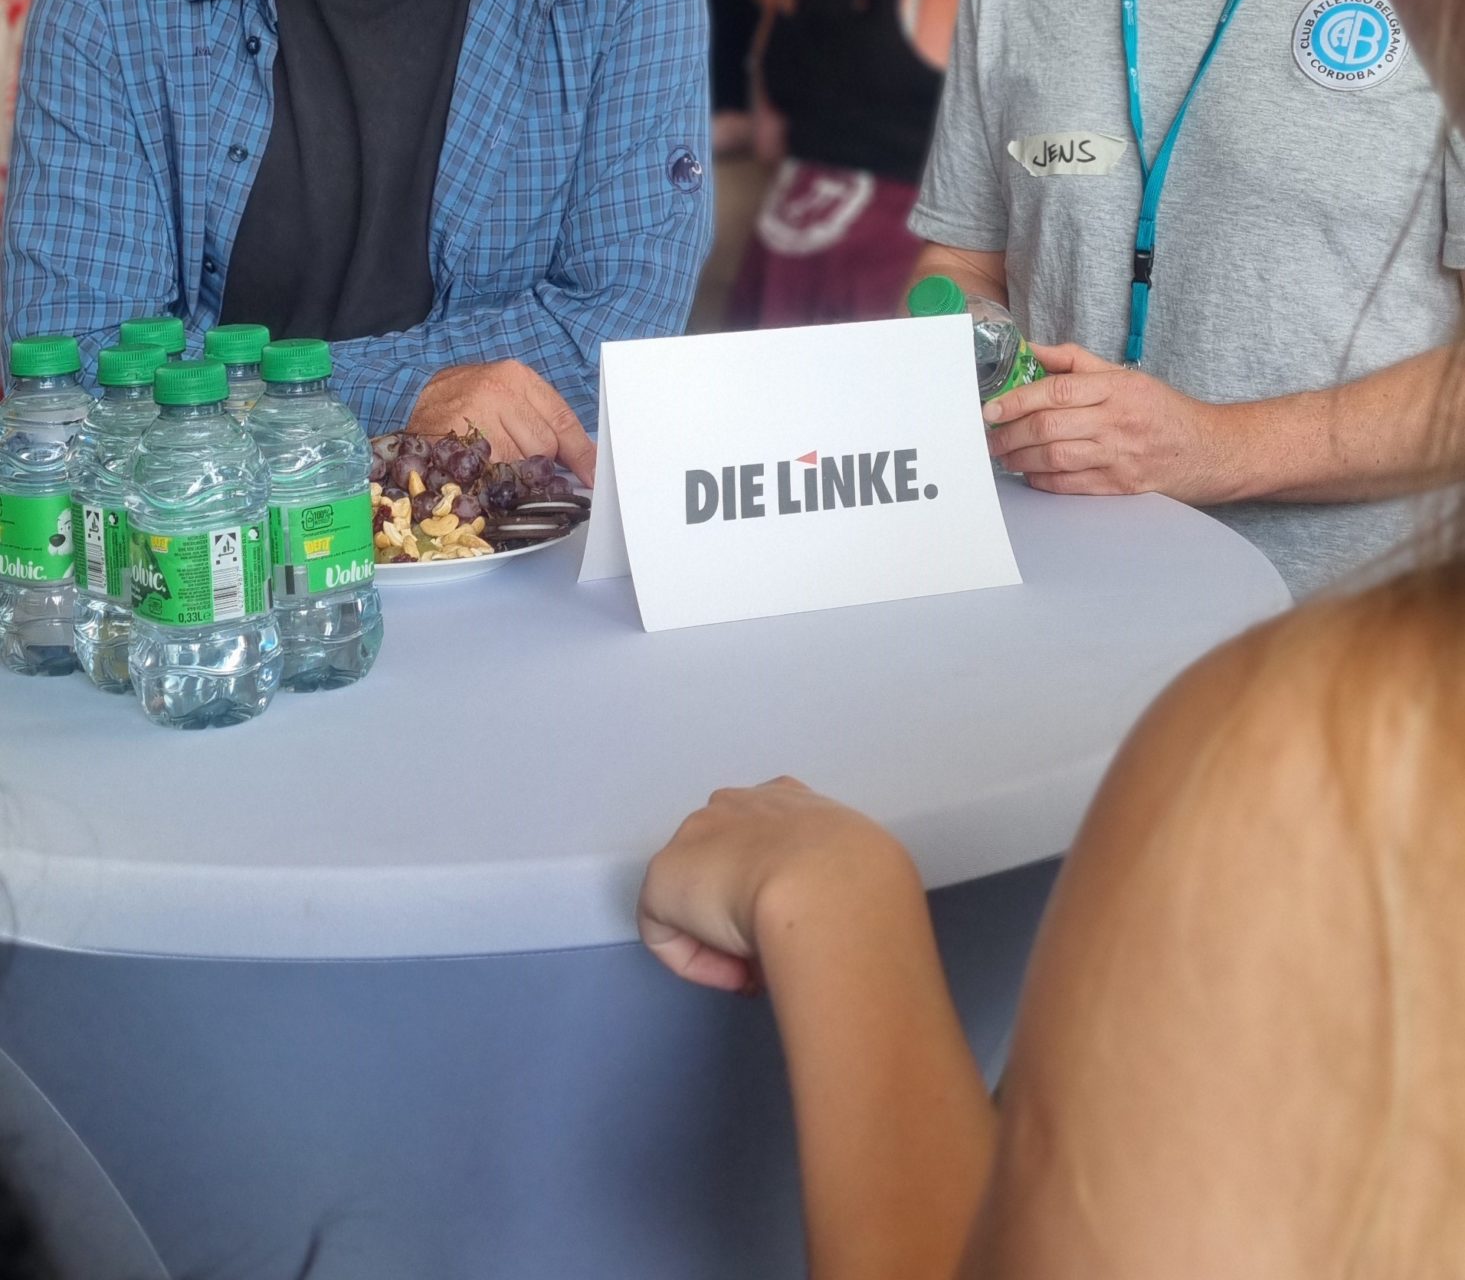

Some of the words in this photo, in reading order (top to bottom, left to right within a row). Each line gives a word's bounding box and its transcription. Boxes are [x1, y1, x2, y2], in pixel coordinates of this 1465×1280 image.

[1300, 19, 1315, 49] CLUB
[1374, 0, 1401, 63] BELGRANO
[1310, 59, 1376, 81] CORDOBA
[1032, 139, 1096, 167] JENS
[685, 463, 766, 525] DIE
[130, 559, 167, 593] olvic.
[178, 611, 203, 624] 0,33L
